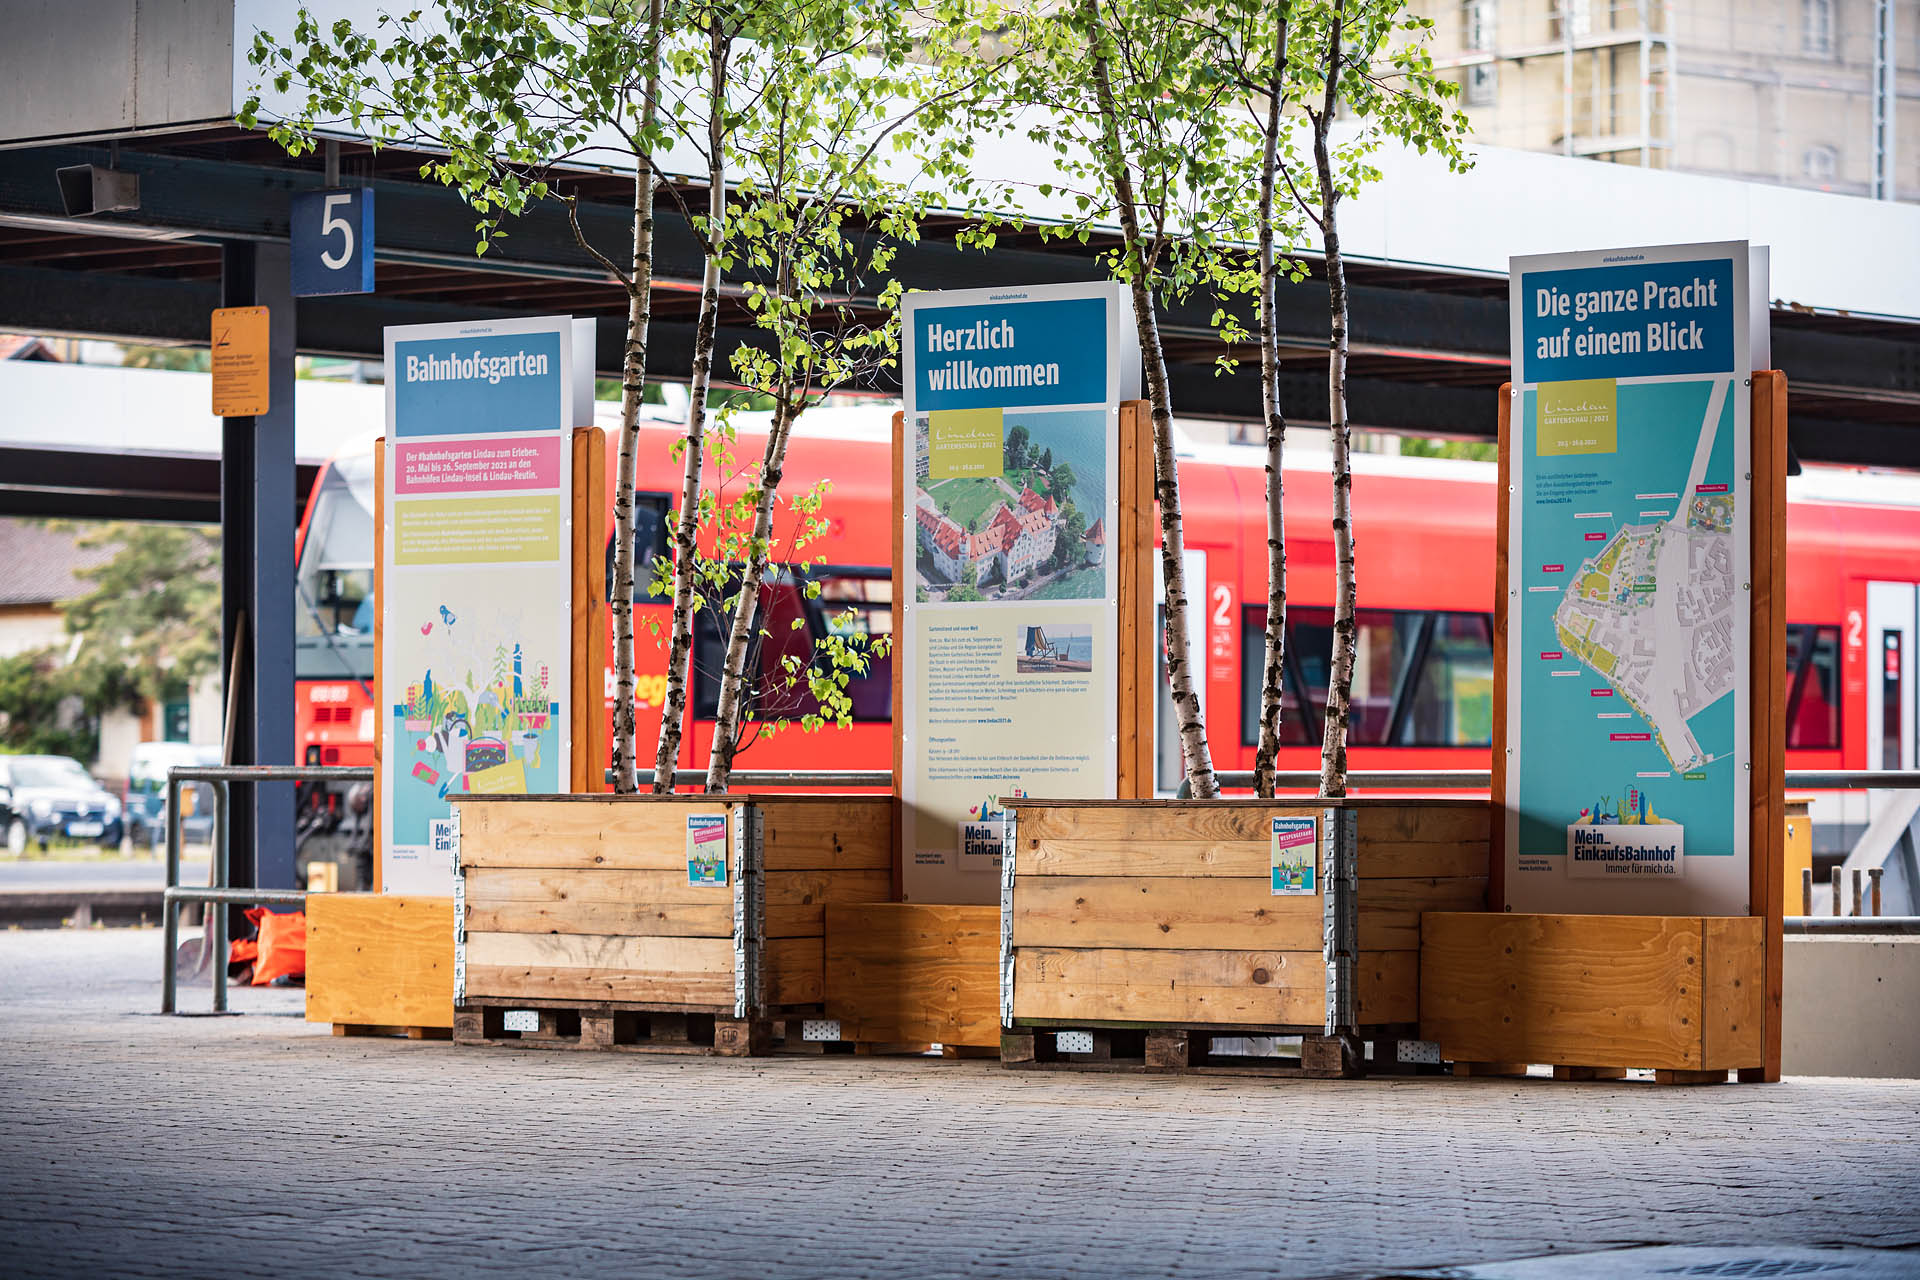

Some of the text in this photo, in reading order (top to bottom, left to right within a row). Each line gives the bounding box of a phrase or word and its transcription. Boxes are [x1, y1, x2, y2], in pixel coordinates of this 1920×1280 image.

[320, 194, 354, 270] 5
[1536, 277, 1718, 322] Die ganze Pracht
[928, 319, 1014, 352] Herzlich
[1536, 320, 1704, 360] auf einem Blick
[406, 350, 548, 384] Bahnhofsgarten
[928, 360, 1060, 391] willkommen
[1544, 416, 1588, 424] GARTENSCHAU
[406, 452, 417, 462] Der
[473, 448, 496, 459] Lindau
[512, 448, 539, 456] Erleben.
[936, 442, 976, 450] GARTENSCHAU
[418, 462, 430, 472] Mai
[431, 462, 441, 472] bis
[455, 460, 490, 472] September
[509, 461, 518, 469] an
[518, 459, 531, 468] den
[442, 472, 482, 482] Lindau-Insel
[1212, 584, 1232, 626] 2
[1848, 610, 1862, 647] 2
[1274, 822, 1310, 830] Bahnhofsgarten
[1574, 845, 1676, 862] EinkaufsBahnhof
[1606, 863, 1676, 874] Immer für mich da.
